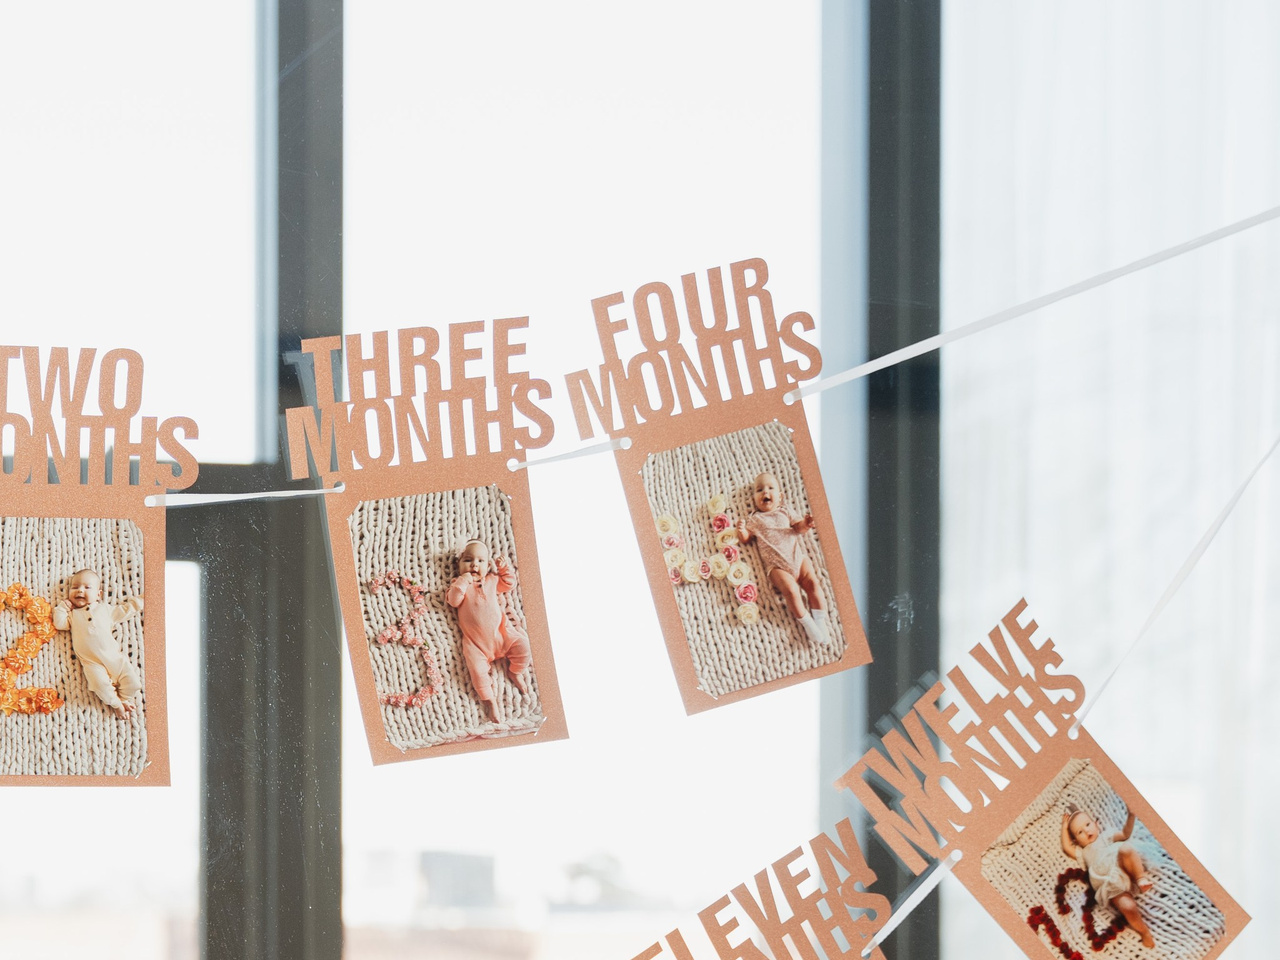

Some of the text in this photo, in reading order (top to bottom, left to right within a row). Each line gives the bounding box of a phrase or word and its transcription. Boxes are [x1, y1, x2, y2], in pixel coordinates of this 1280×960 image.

[301, 316, 530, 408] THREE
[591, 257, 776, 363] FOUR
[285, 377, 555, 481] MONTHS
[565, 311, 823, 440] MONTHS
[834, 597, 1064, 812] TWELVE
[874, 651, 1086, 876] MONTHS
